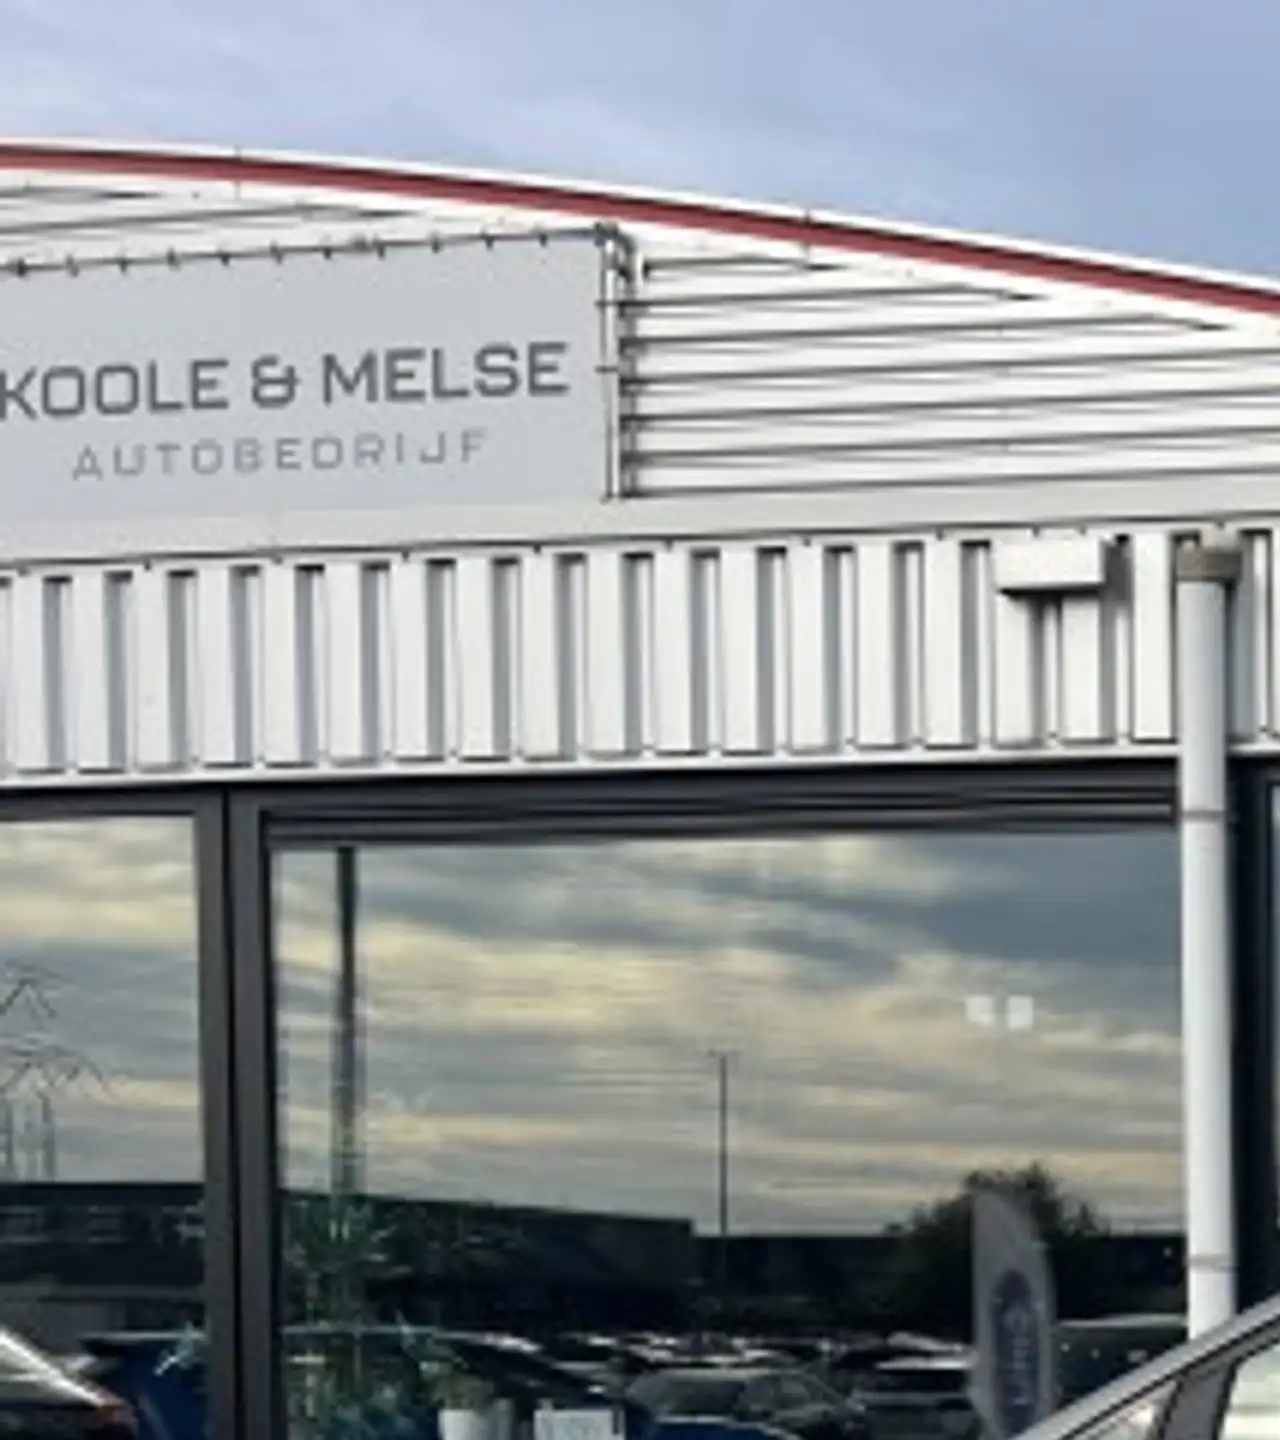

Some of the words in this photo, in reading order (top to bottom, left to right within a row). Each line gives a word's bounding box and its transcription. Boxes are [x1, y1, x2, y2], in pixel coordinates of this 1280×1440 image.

[0, 360, 229, 421] KOOLE
[252, 356, 300, 410] &
[323, 342, 570, 405] MELSE
[73, 430, 487, 481] AUTOBEDRIJF
